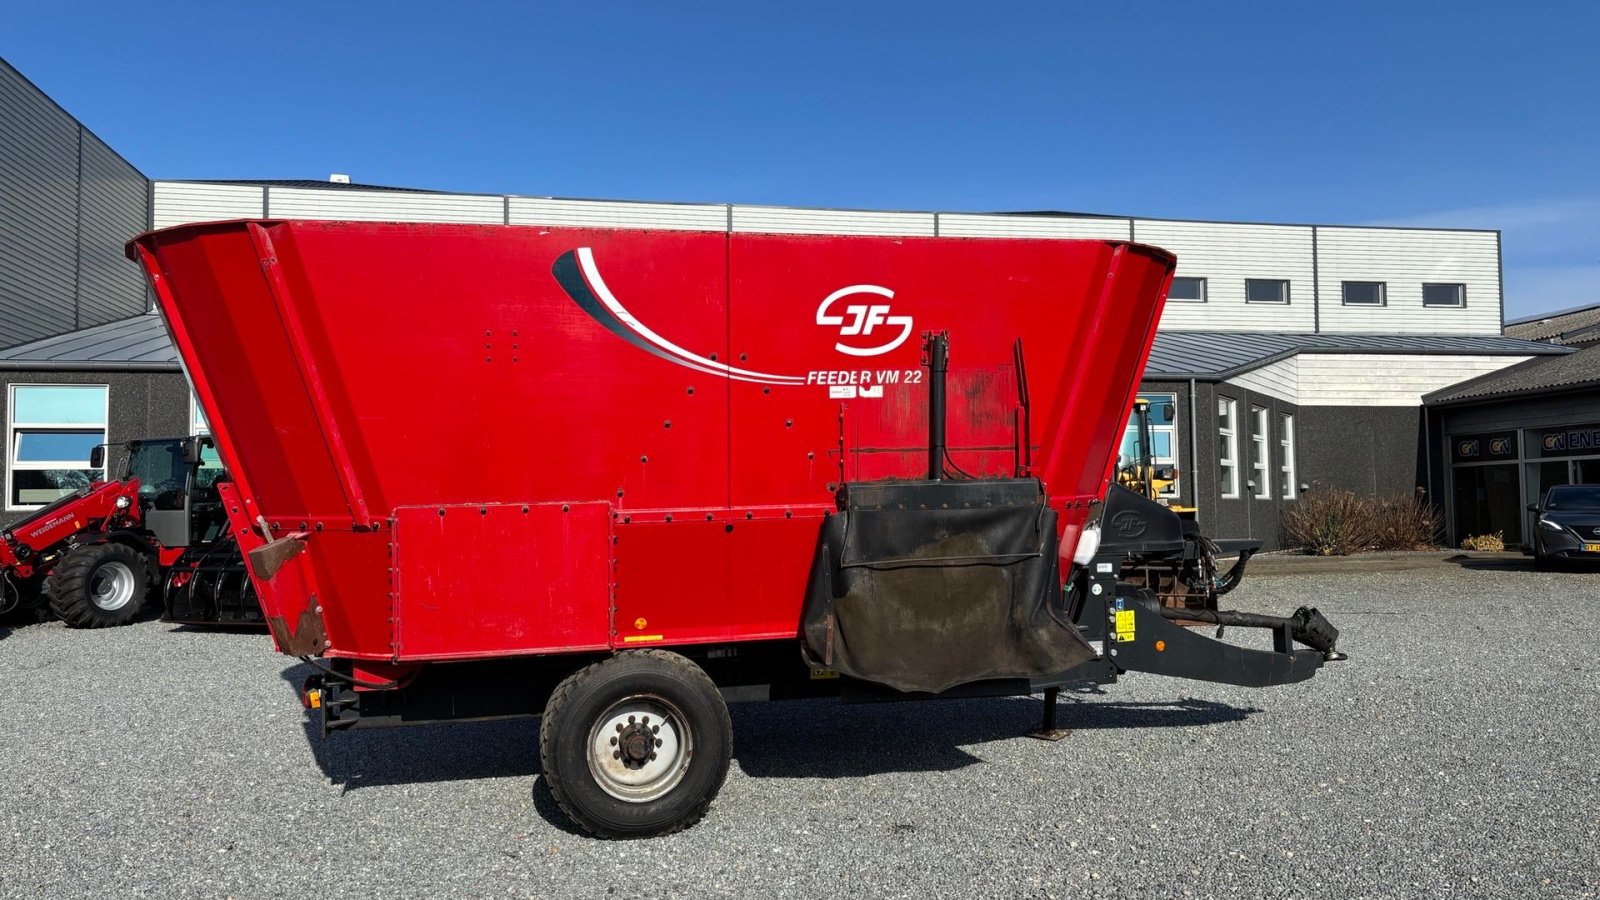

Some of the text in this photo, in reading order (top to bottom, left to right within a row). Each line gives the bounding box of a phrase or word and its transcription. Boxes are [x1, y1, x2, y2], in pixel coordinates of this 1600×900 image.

[839, 304, 891, 336] JF
[806, 369, 923, 385] FEEDER VM 22
[30, 512, 75, 538] WEIDEMANN
